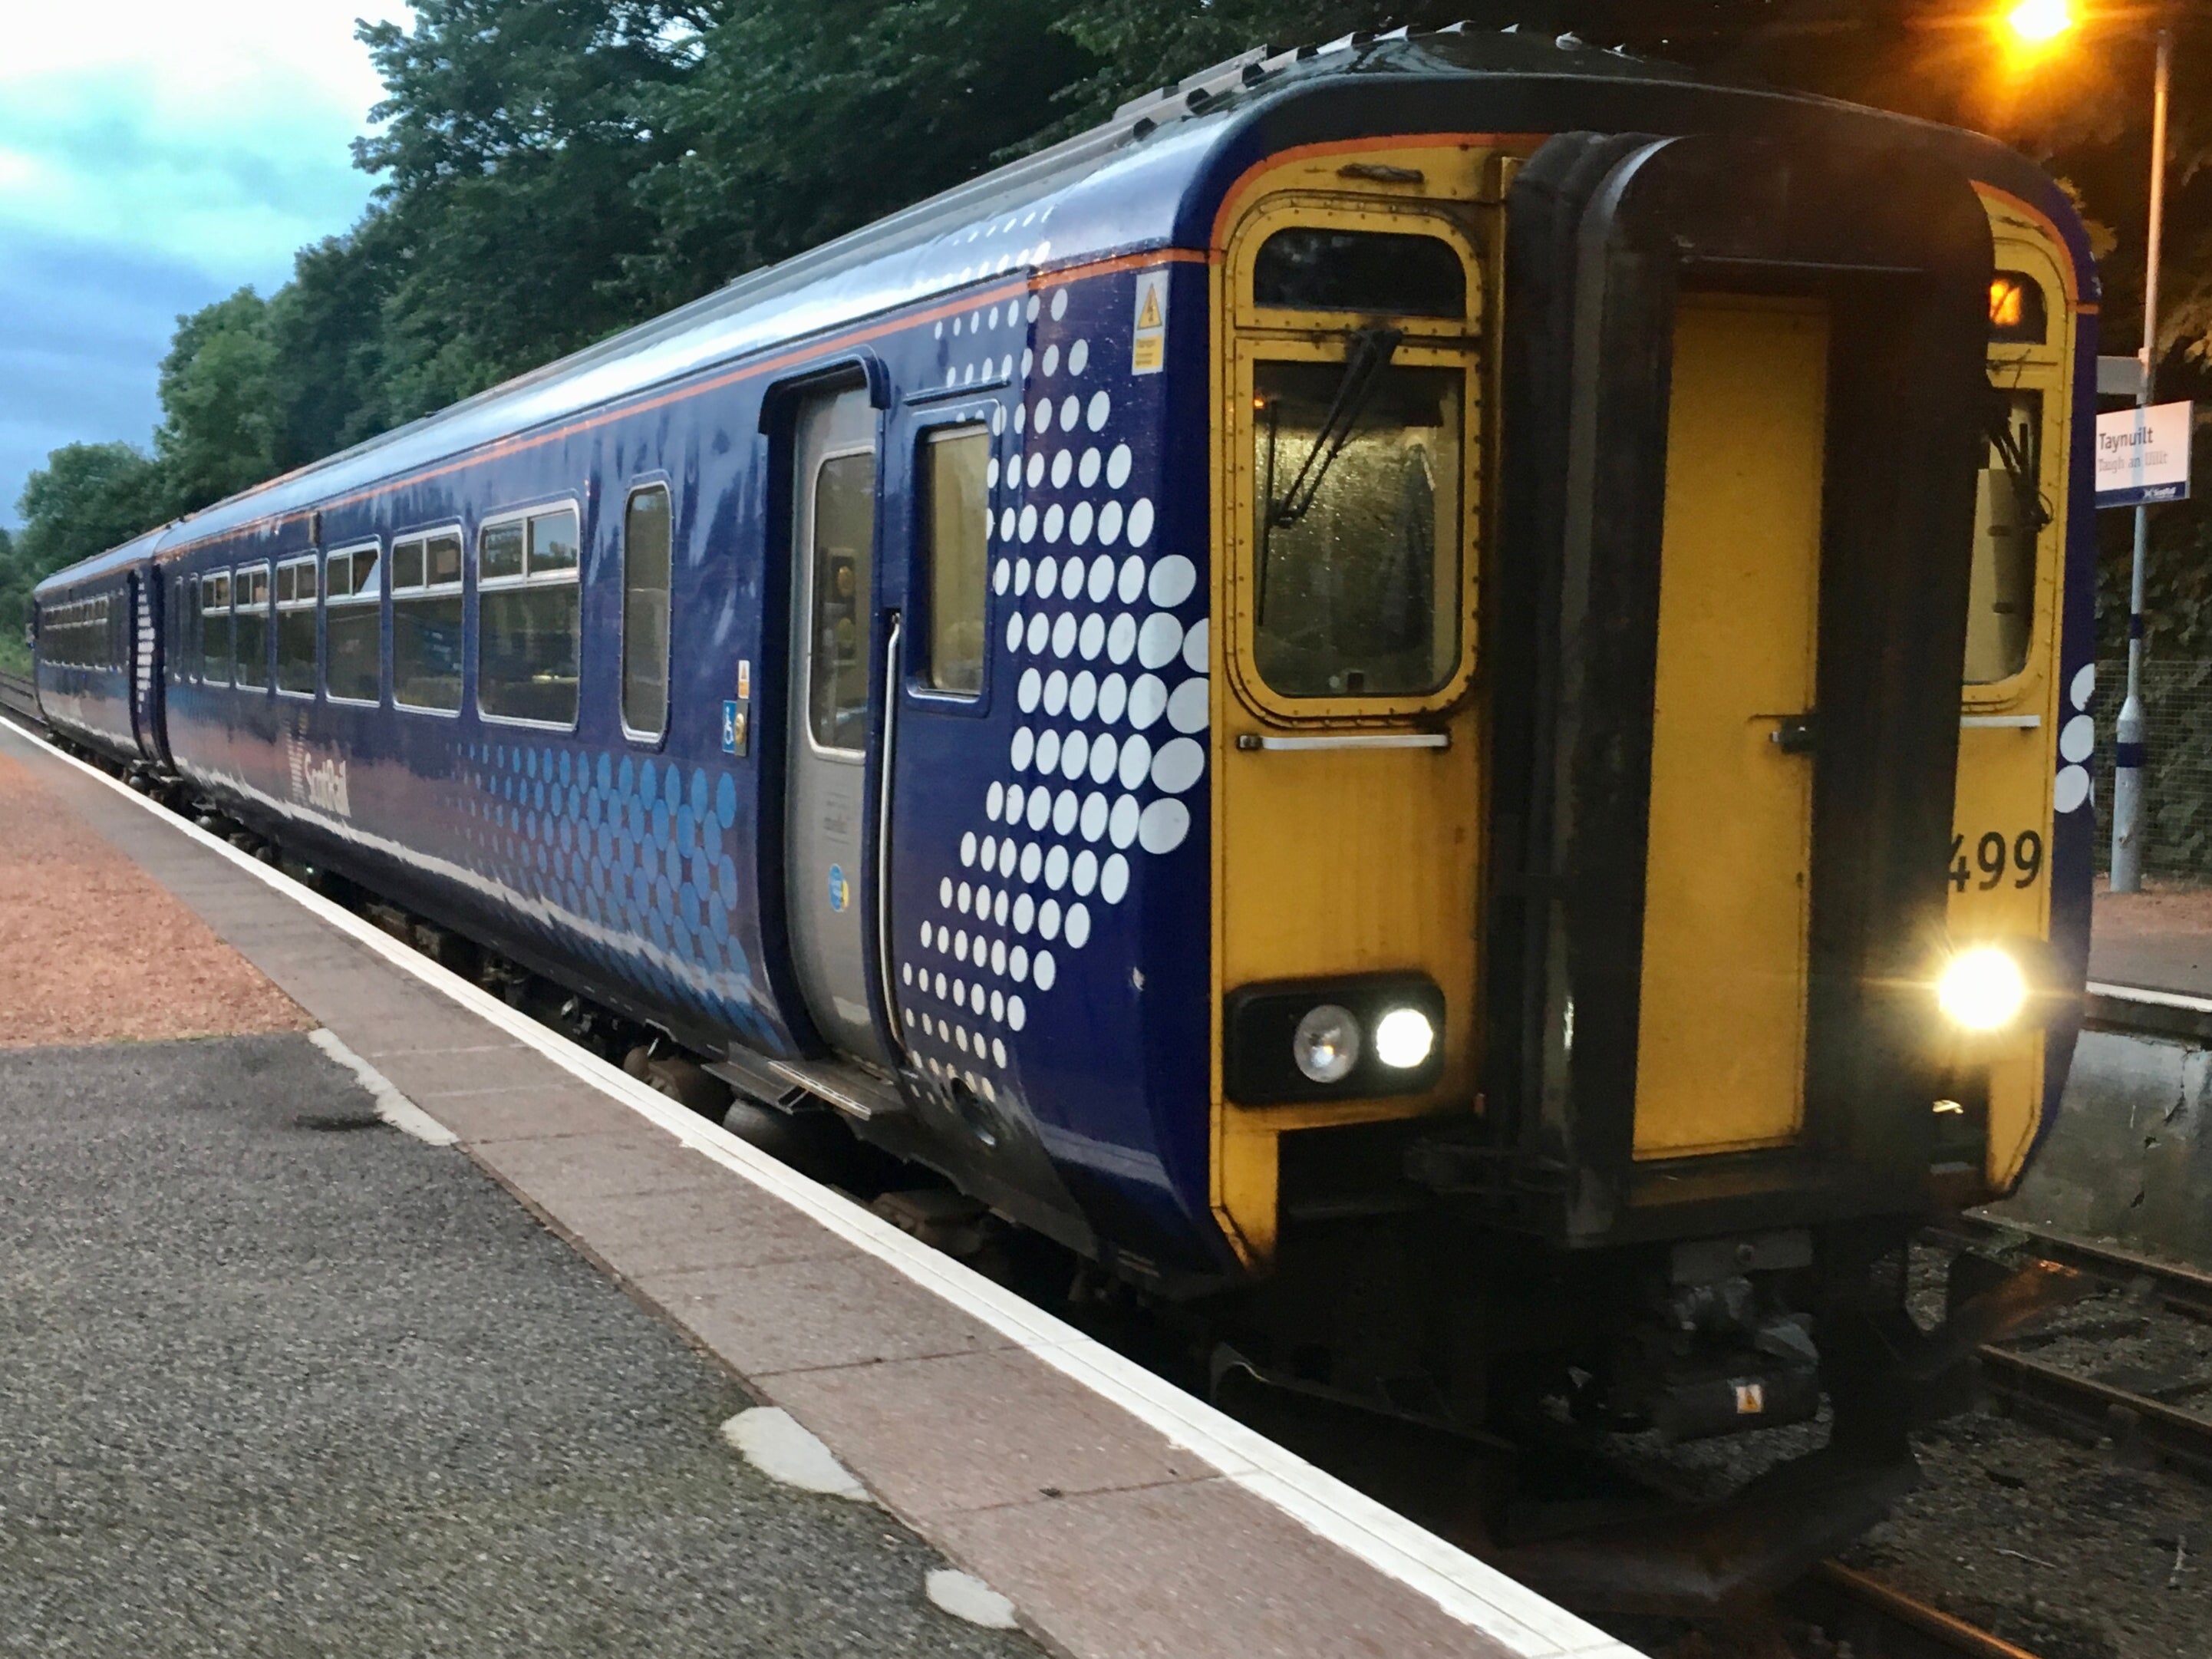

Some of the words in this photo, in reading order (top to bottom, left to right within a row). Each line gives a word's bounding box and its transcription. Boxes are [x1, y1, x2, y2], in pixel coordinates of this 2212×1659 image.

[2099, 427, 2154, 453] Taynuilt
[2128, 457, 2141, 468] an
[1948, 830, 2042, 892] 499
